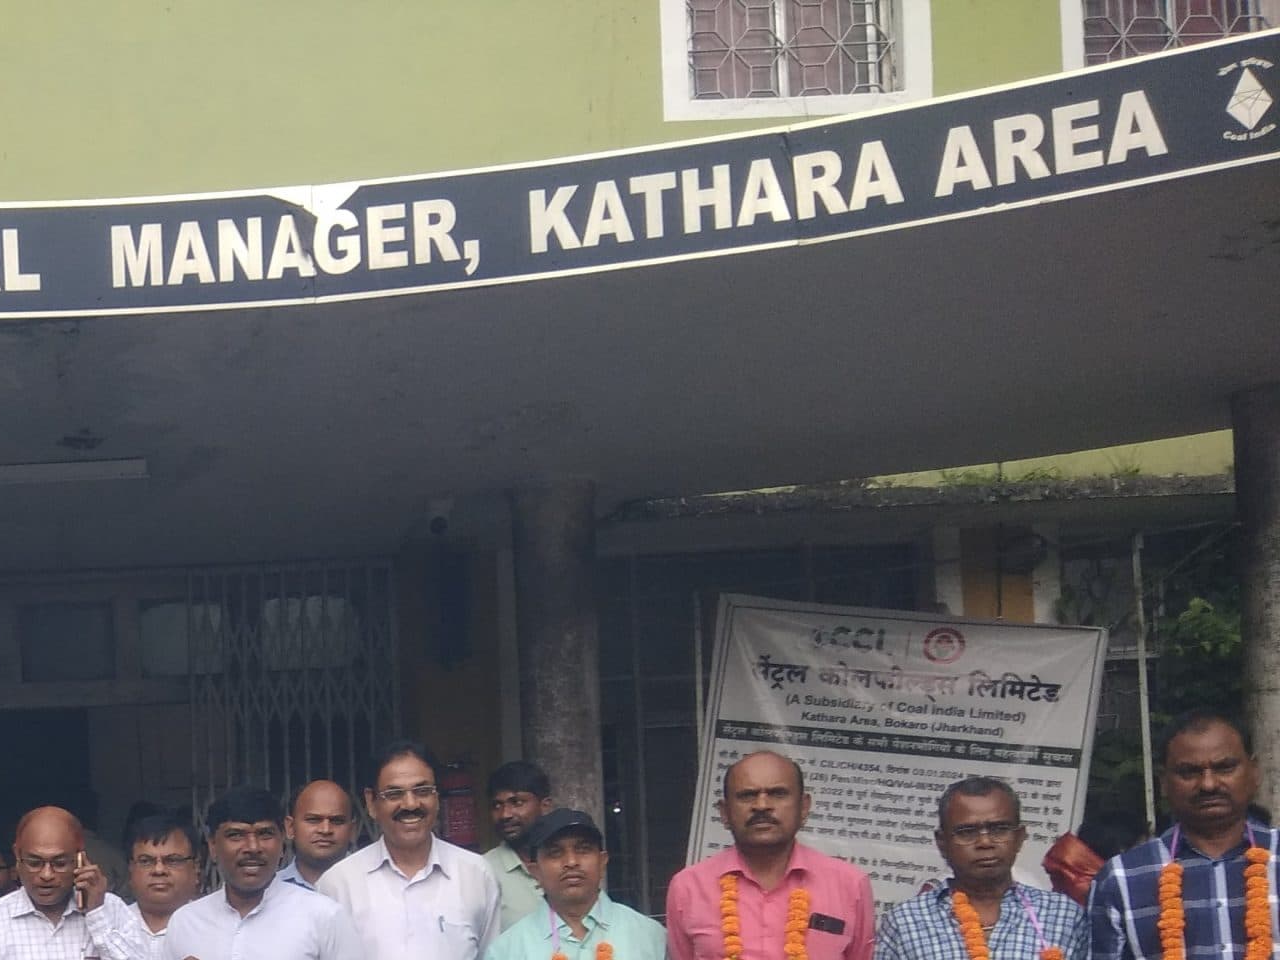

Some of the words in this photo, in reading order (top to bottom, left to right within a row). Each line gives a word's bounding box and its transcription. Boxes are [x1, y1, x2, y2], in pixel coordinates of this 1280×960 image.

[110, 198, 481, 289] MANAGER,
[528, 140, 905, 254] KATHARA
[935, 90, 1168, 198] AREA
[967, 670, 1062, 703] लिमिटेड
[786, 694, 800, 706] (A
[897, 701, 928, 715] Coal
[931, 704, 966, 718] India
[969, 706, 1027, 724] Limited)
[801, 711, 847, 725] Kathara
[884, 717, 928, 731] Bokaro
[931, 719, 1004, 739] (Jharkhand)
